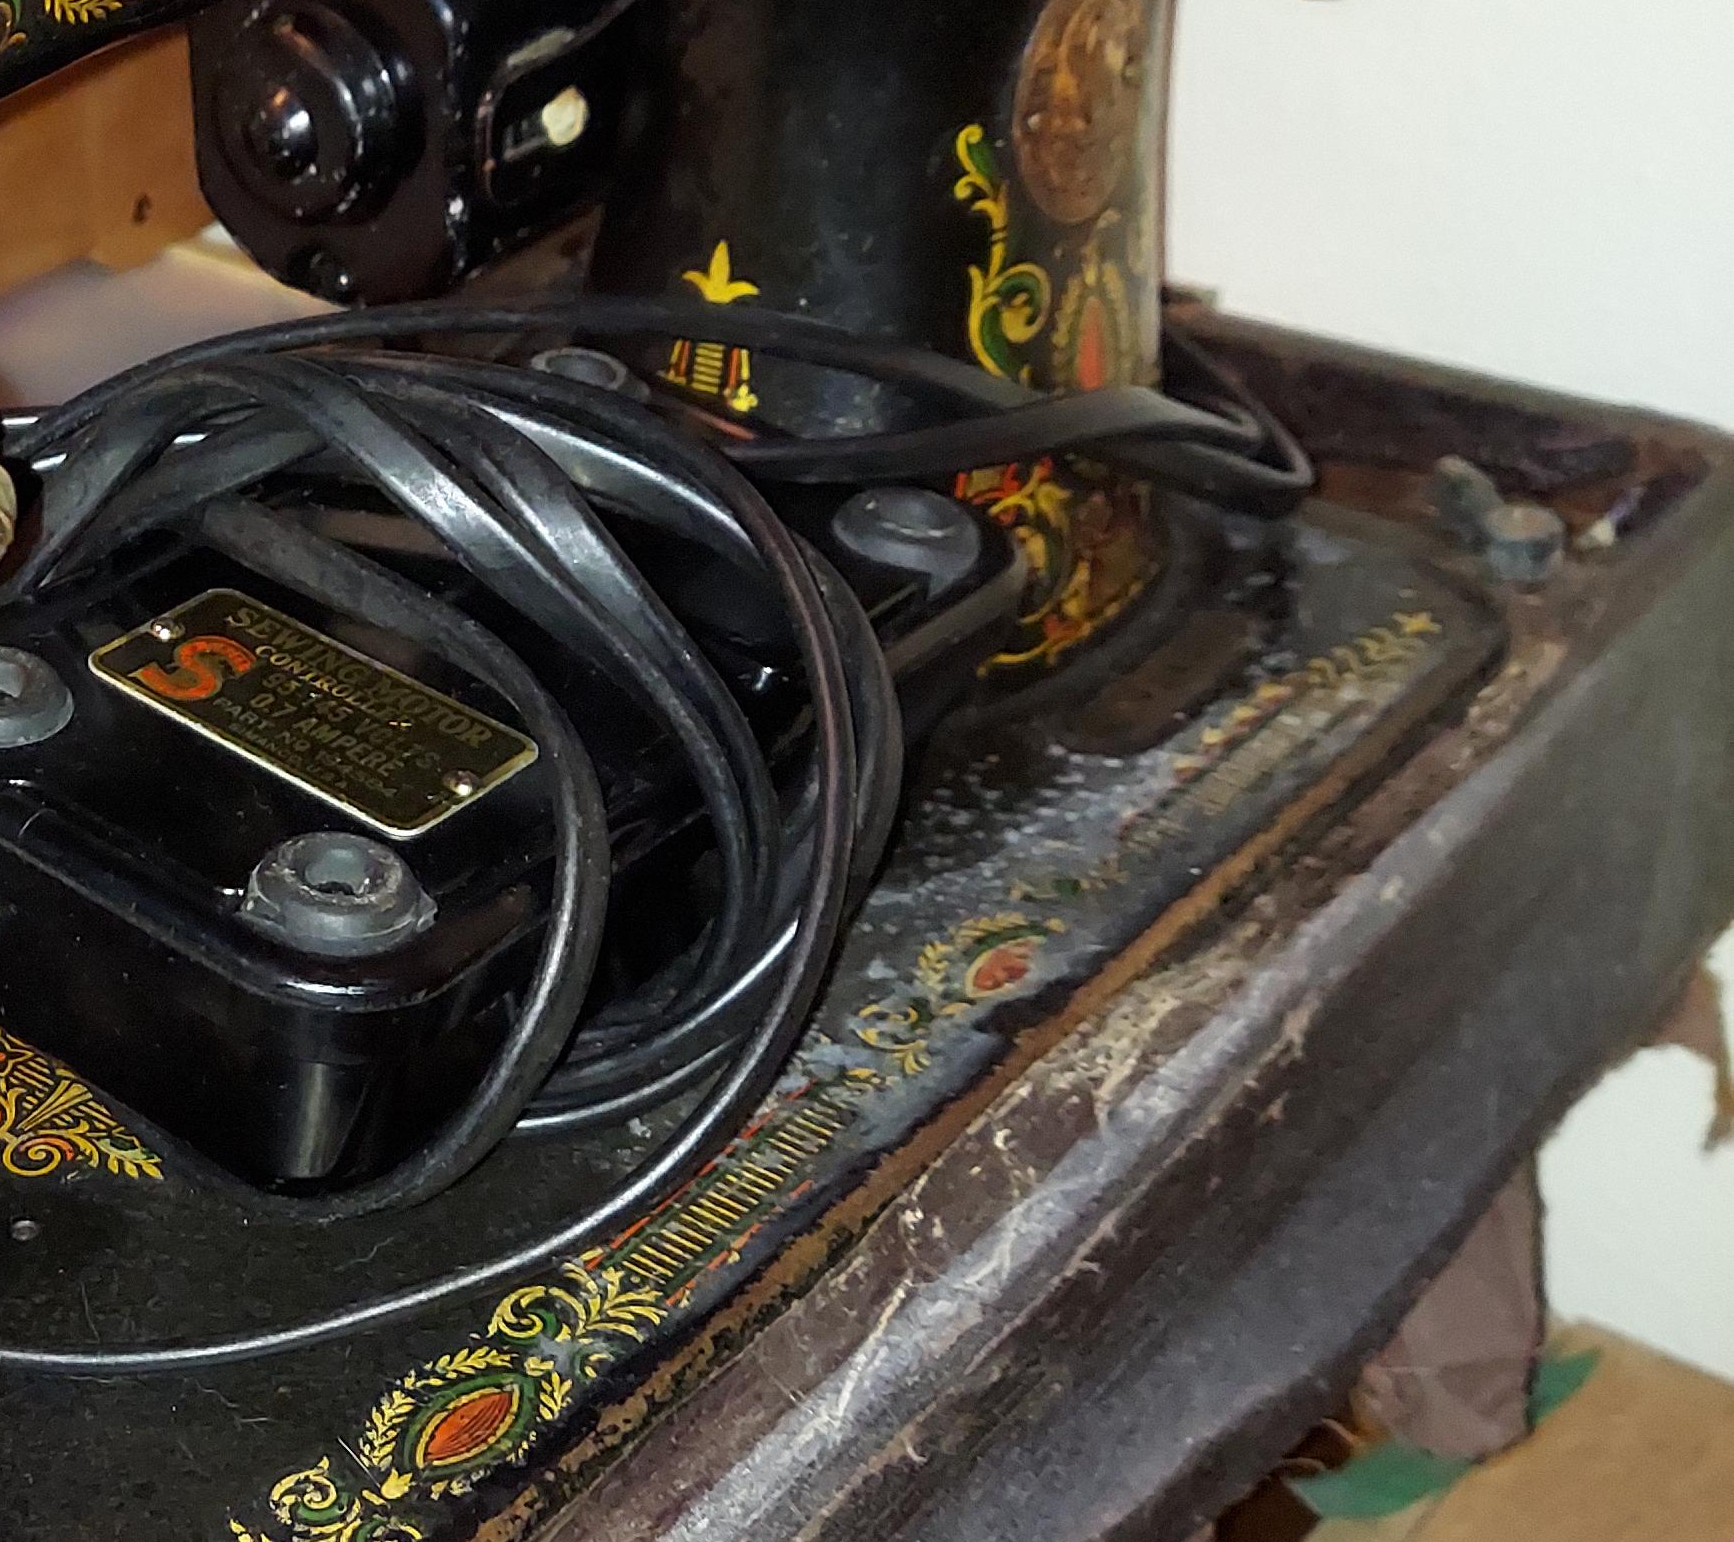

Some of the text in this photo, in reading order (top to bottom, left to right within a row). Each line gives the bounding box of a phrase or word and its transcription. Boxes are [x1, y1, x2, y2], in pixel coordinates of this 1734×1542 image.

[212, 696, 276, 730] PART
[225, 607, 493, 748] SEWING MOTOR
[249, 692, 406, 778] 0.7 AMPERE
